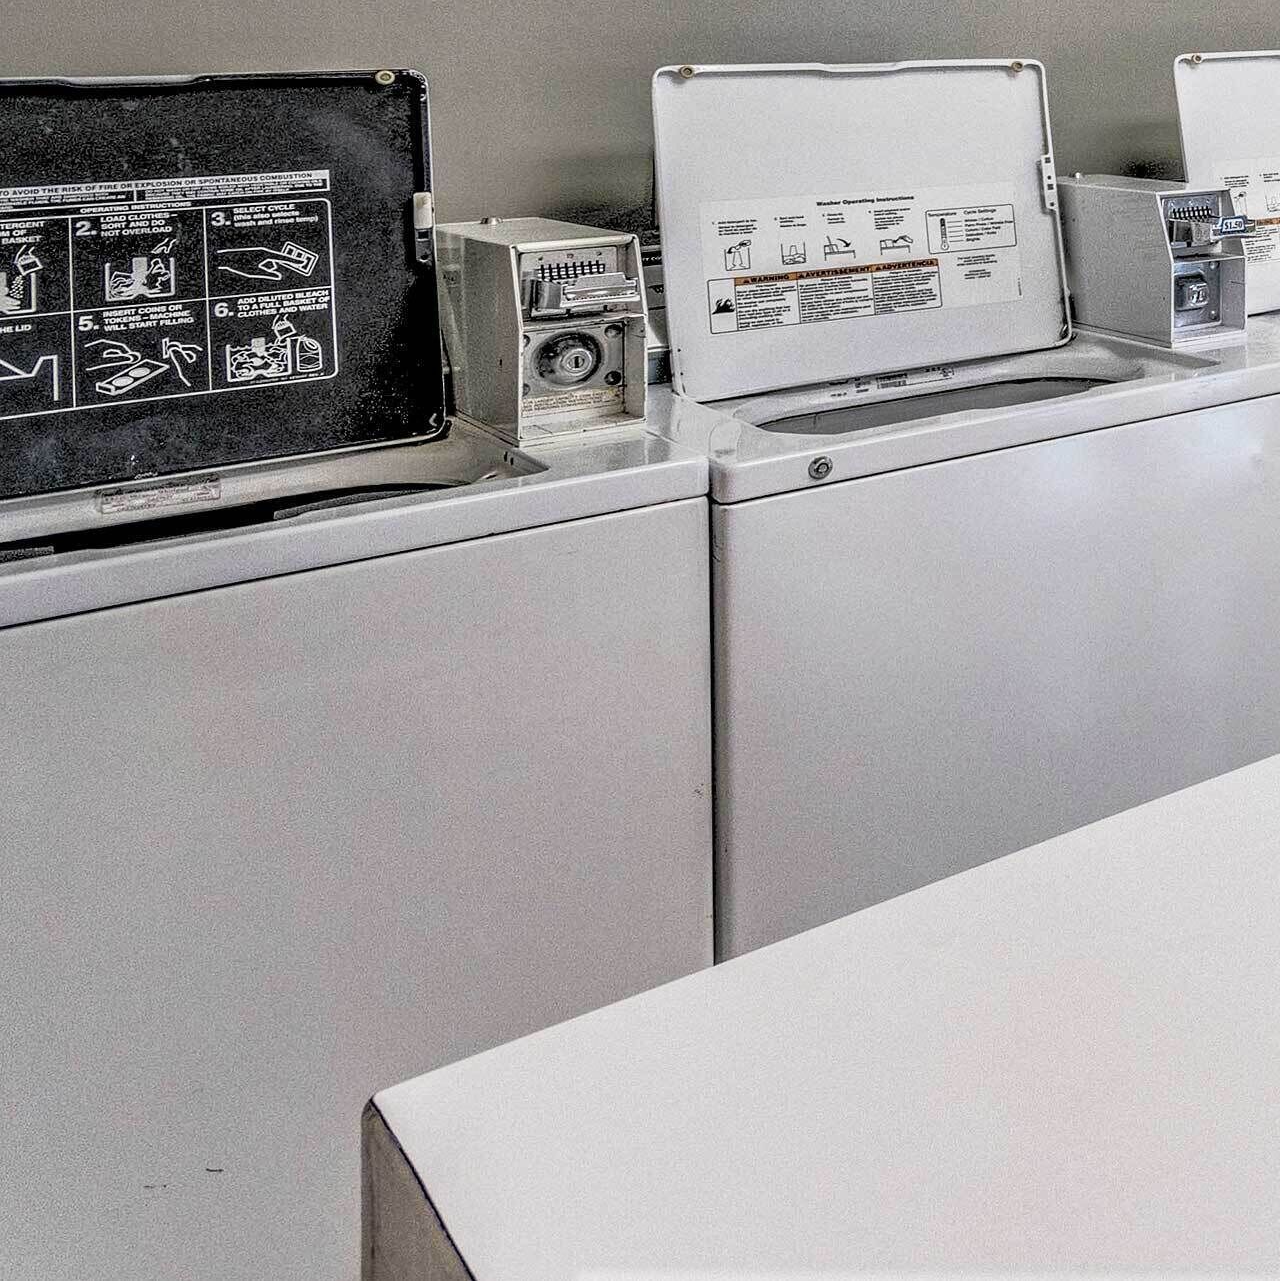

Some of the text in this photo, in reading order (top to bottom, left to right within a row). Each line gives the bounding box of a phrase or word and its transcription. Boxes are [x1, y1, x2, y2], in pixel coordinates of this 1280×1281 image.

[12, 188, 39, 196] AVOID
[135, 180, 182, 188] EXPLOSION
[199, 175, 257, 185] SPONTANEOUS
[259, 173, 312, 181] COMBUSTION
[80, 202, 191, 213] OPERATING INSTRUCTIONS
[843, 198, 875, 206] Operating
[233, 204, 295, 214] SELECT CYCLE
[253, 211, 270, 219] also
[272, 209, 300, 218] selects
[100, 214, 125, 223] LOAD
[127, 212, 170, 221] CLOTHES
[211, 211, 231, 226] 3.
[234, 219, 256, 227] wash
[257, 218, 273, 226] and
[75, 221, 97, 236] 2.
[101, 221, 126, 230] SORT
[129, 220, 149, 228] AND
[1224, 221, 1243, 230] $1.50
[12, 229, 27, 237] OF
[101, 226, 172, 237] NOT OVERLOAD
[2, 236, 42, 244] BASKET
[750, 273, 790, 282] WARNING
[805, 266, 871, 278] AVERTISSEMENT
[238, 290, 329, 305] ADD DILUTED BLEACH
[260, 300, 281, 309] FULL
[283, 297, 316, 306] BASKET
[103, 304, 183, 317] INSERT COINS OR
[214, 302, 234, 317] 6.
[237, 303, 329, 318] CLOTHES AND WATER
[78, 315, 99, 331] 5.
[103, 316, 141, 325] TOKENS
[150, 310, 191, 320] MACHINE
[15, 324, 32, 332] LID
[104, 316, 194, 332] WILL START FILLING
